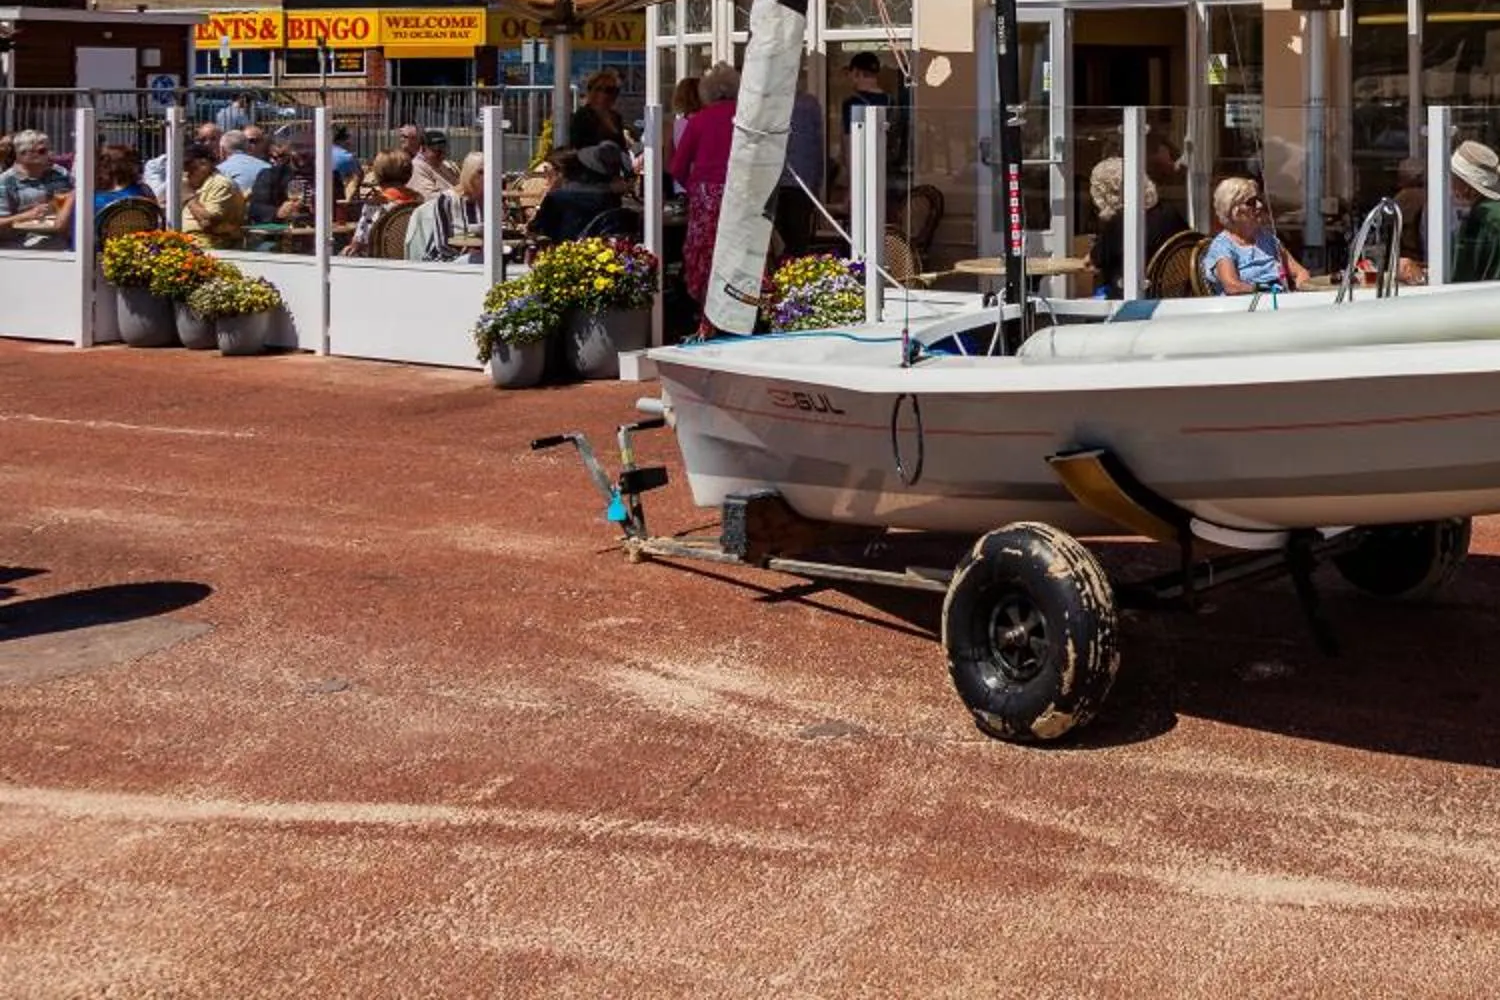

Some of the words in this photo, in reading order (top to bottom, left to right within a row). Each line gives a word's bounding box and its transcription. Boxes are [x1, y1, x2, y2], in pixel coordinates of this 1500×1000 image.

[288, 16, 370, 40] BINGO
[385, 15, 478, 29] WELCOME
[592, 18, 637, 41] BAY
[409, 30, 447, 39] OCEAN
[449, 30, 471, 39] BAY
